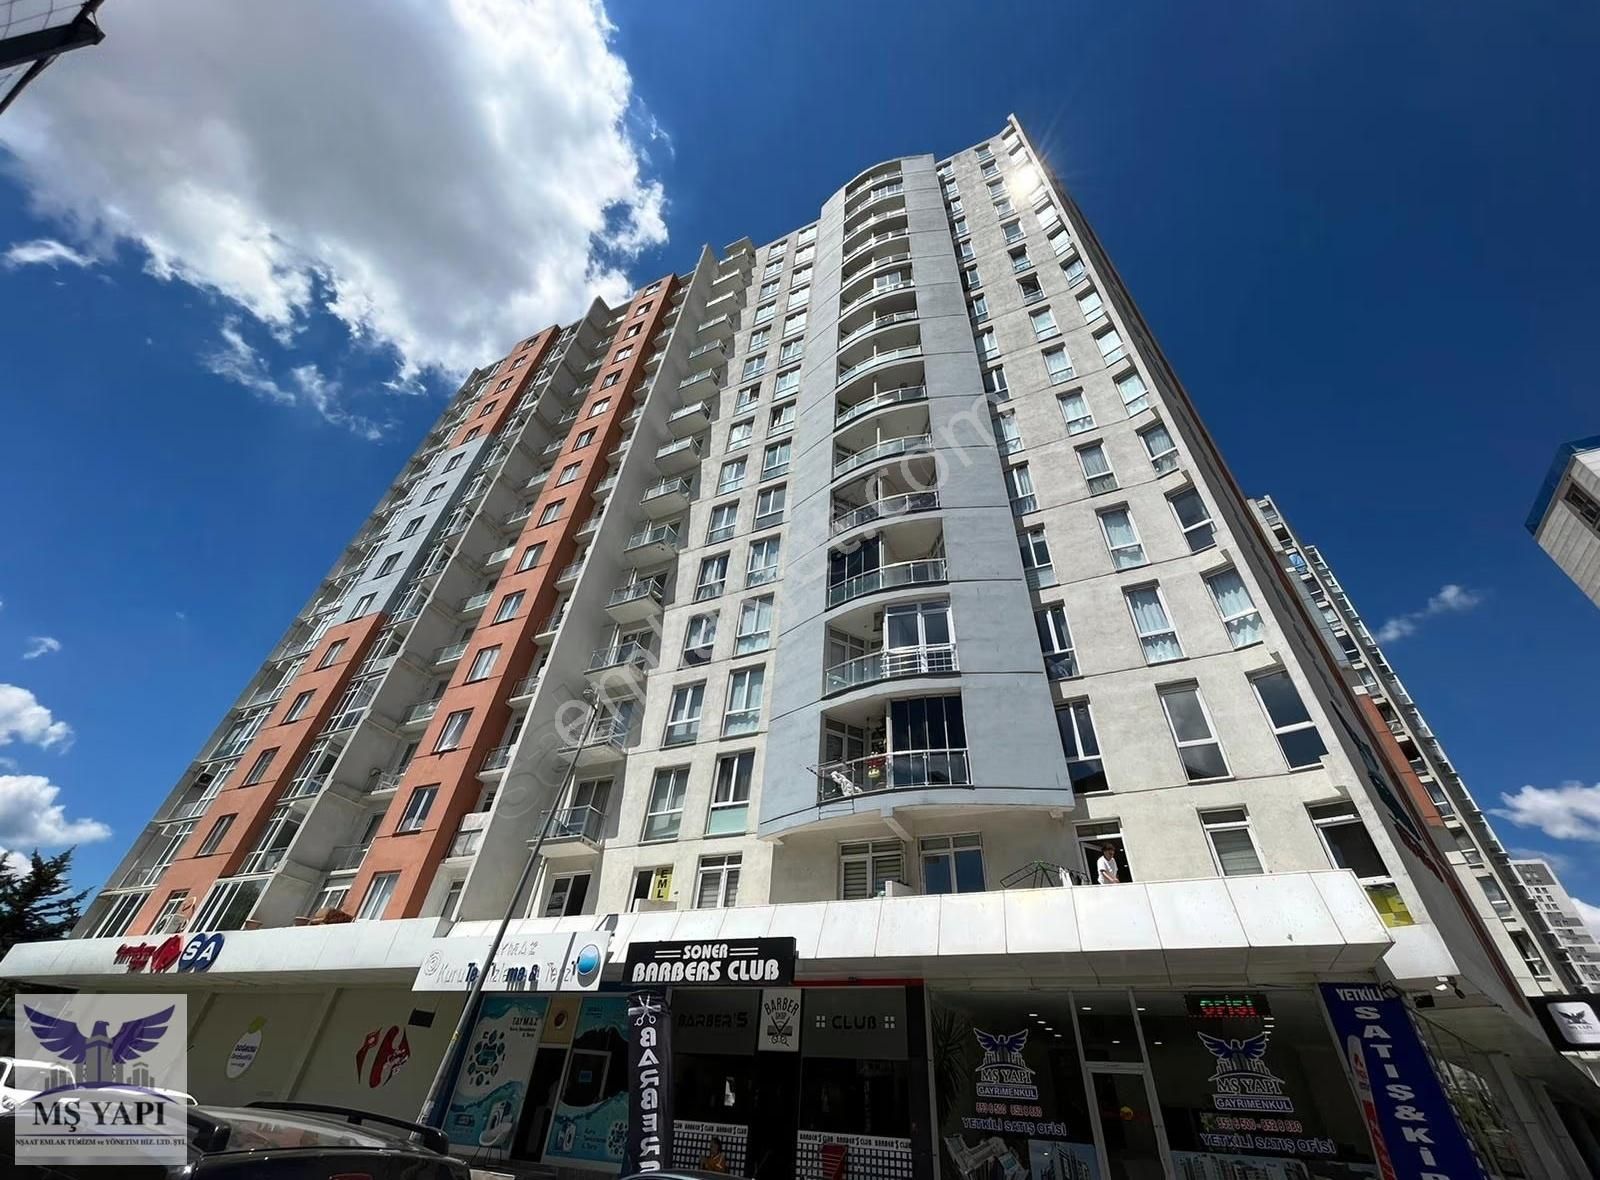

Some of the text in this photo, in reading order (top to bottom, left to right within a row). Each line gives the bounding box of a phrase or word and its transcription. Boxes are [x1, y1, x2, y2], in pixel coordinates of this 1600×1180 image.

[182, 941, 216, 961] SA
[683, 944, 728, 959] SONER
[466, 962, 528, 983] Teizleme
[529, 964, 540, 982] &
[544, 960, 577, 983] Tezi
[632, 958, 780, 982] BARBERS CLUB
[764, 997, 800, 1017] BARBER
[831, 1015, 877, 1030] CLUB
[1000, 1069, 1032, 1084] YAPI
[1240, 1079, 1282, 1095] YAPI
[1200, 1133, 1337, 1154] YETKİLİ SATIŞ OFİSİ
